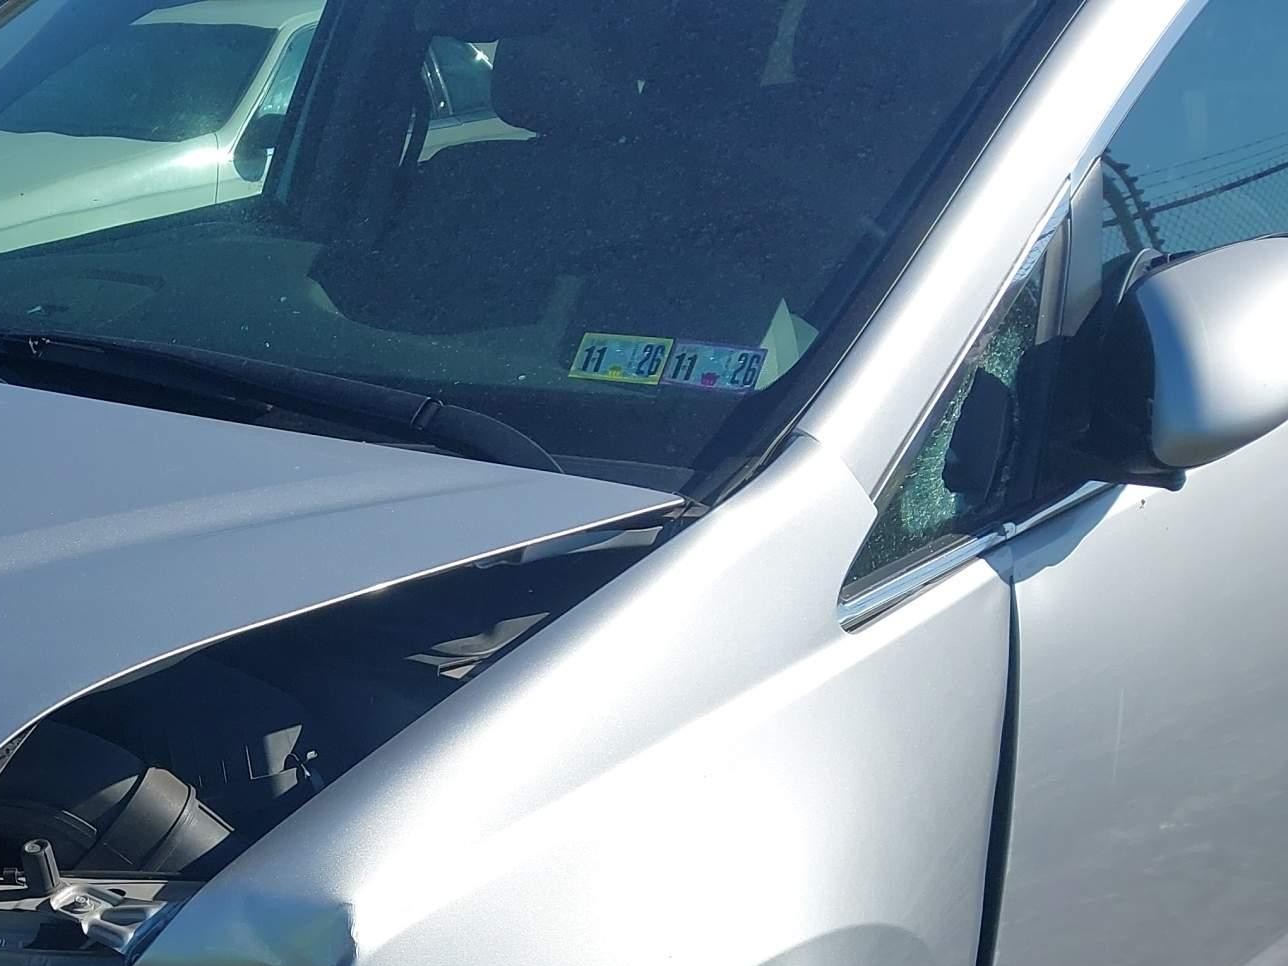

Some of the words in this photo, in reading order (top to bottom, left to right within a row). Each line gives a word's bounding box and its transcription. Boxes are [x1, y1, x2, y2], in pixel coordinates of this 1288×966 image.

[581, 345, 608, 373] 11
[635, 343, 665, 376] 26
[672, 352, 698, 381] 11
[730, 352, 760, 386] 26
